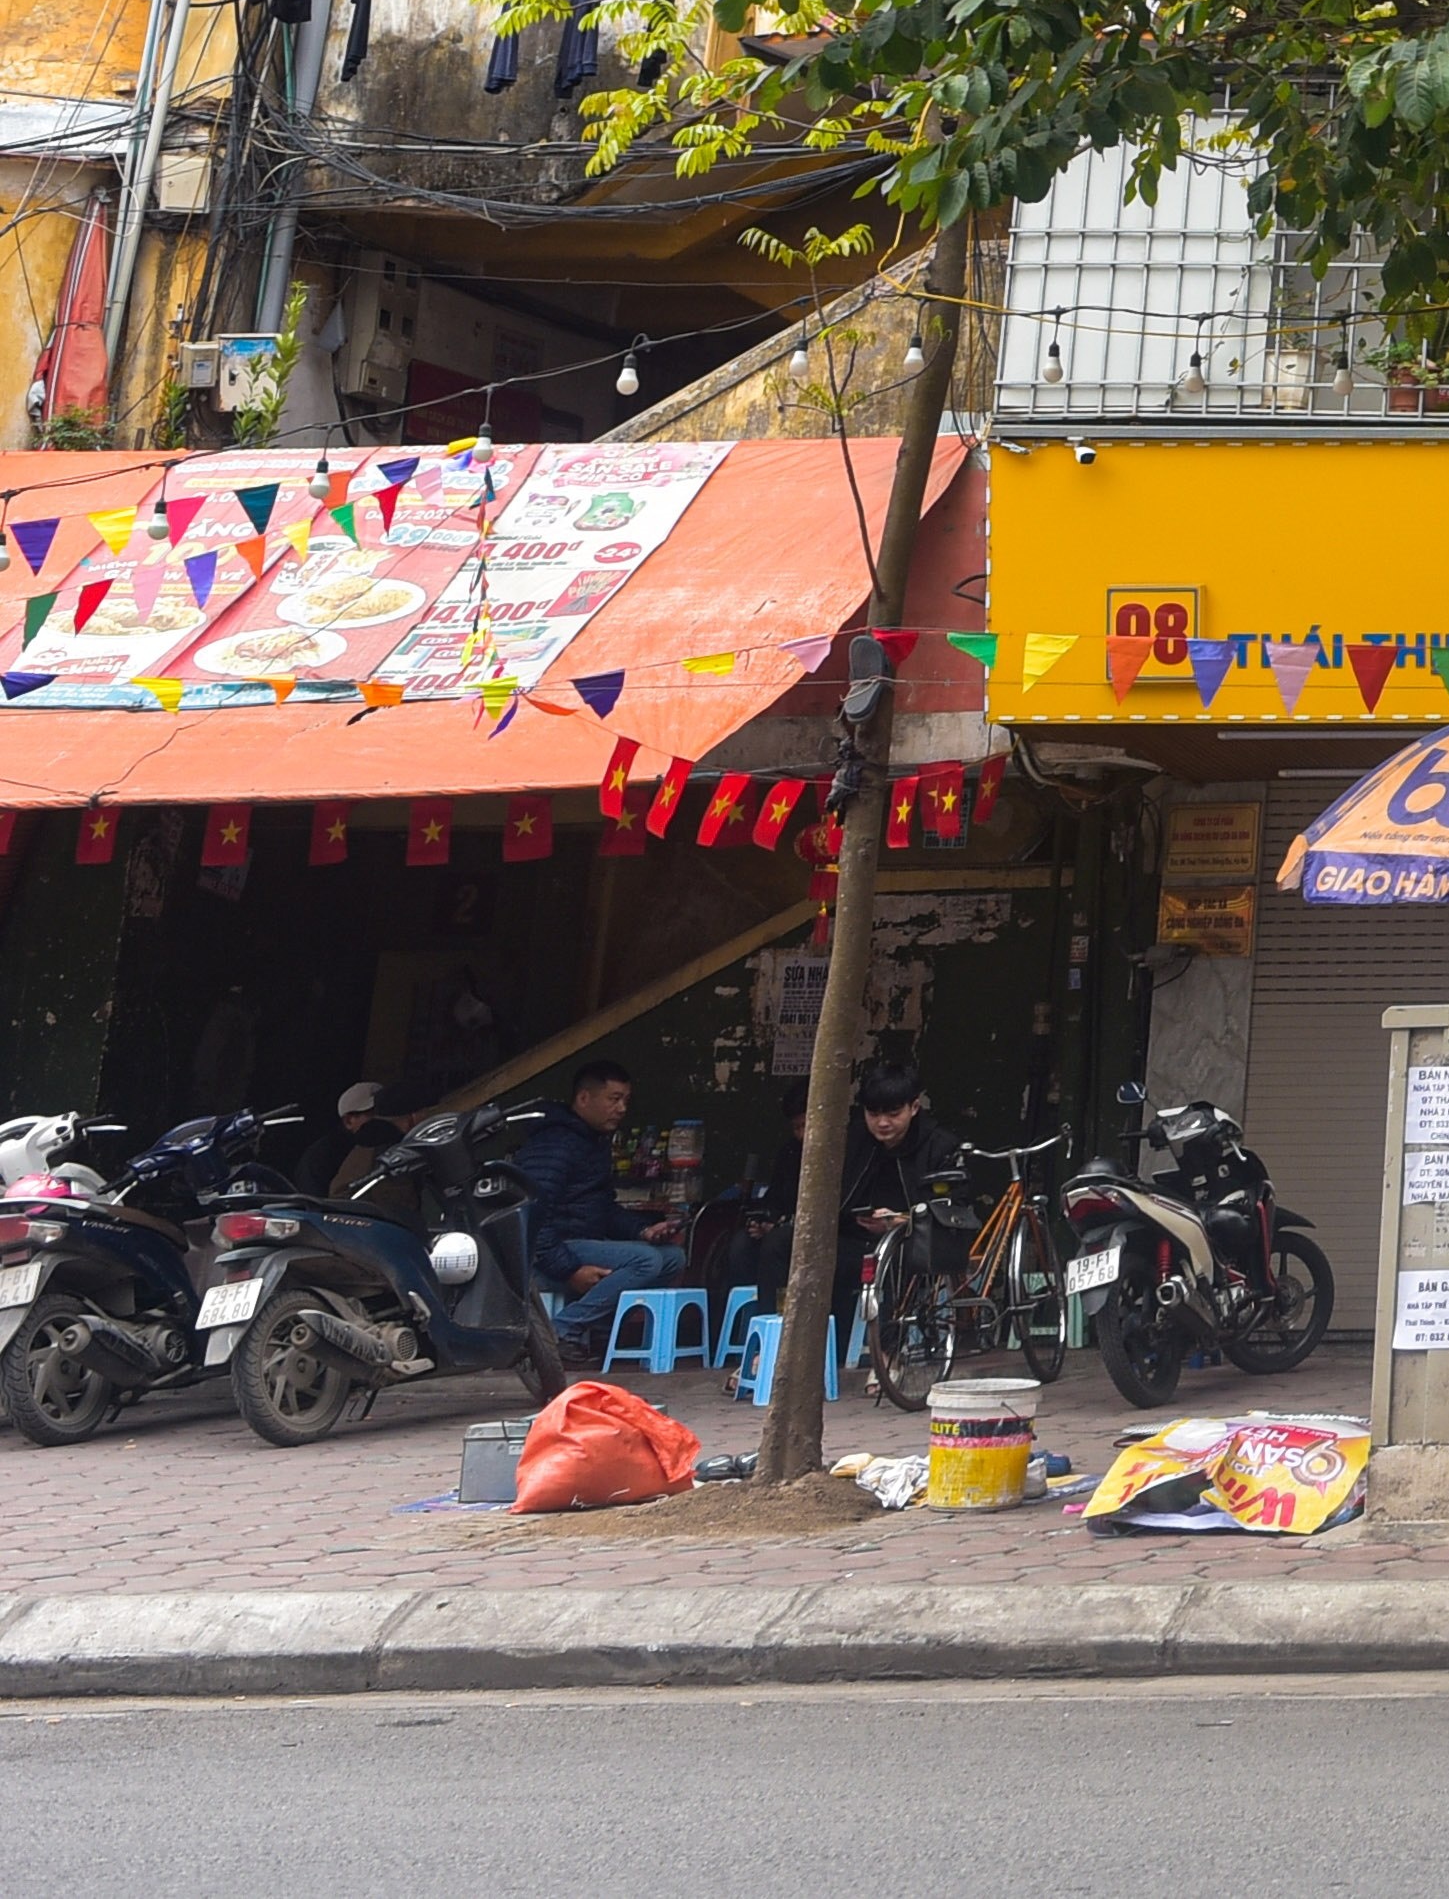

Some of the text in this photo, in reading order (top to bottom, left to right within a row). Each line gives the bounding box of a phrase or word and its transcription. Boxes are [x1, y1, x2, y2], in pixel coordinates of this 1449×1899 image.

[1316, 865, 1392, 894] GIAO
[1418, 1067, 1442, 1081] BÁN
[1418, 1278, 1438, 1293] BÁN
